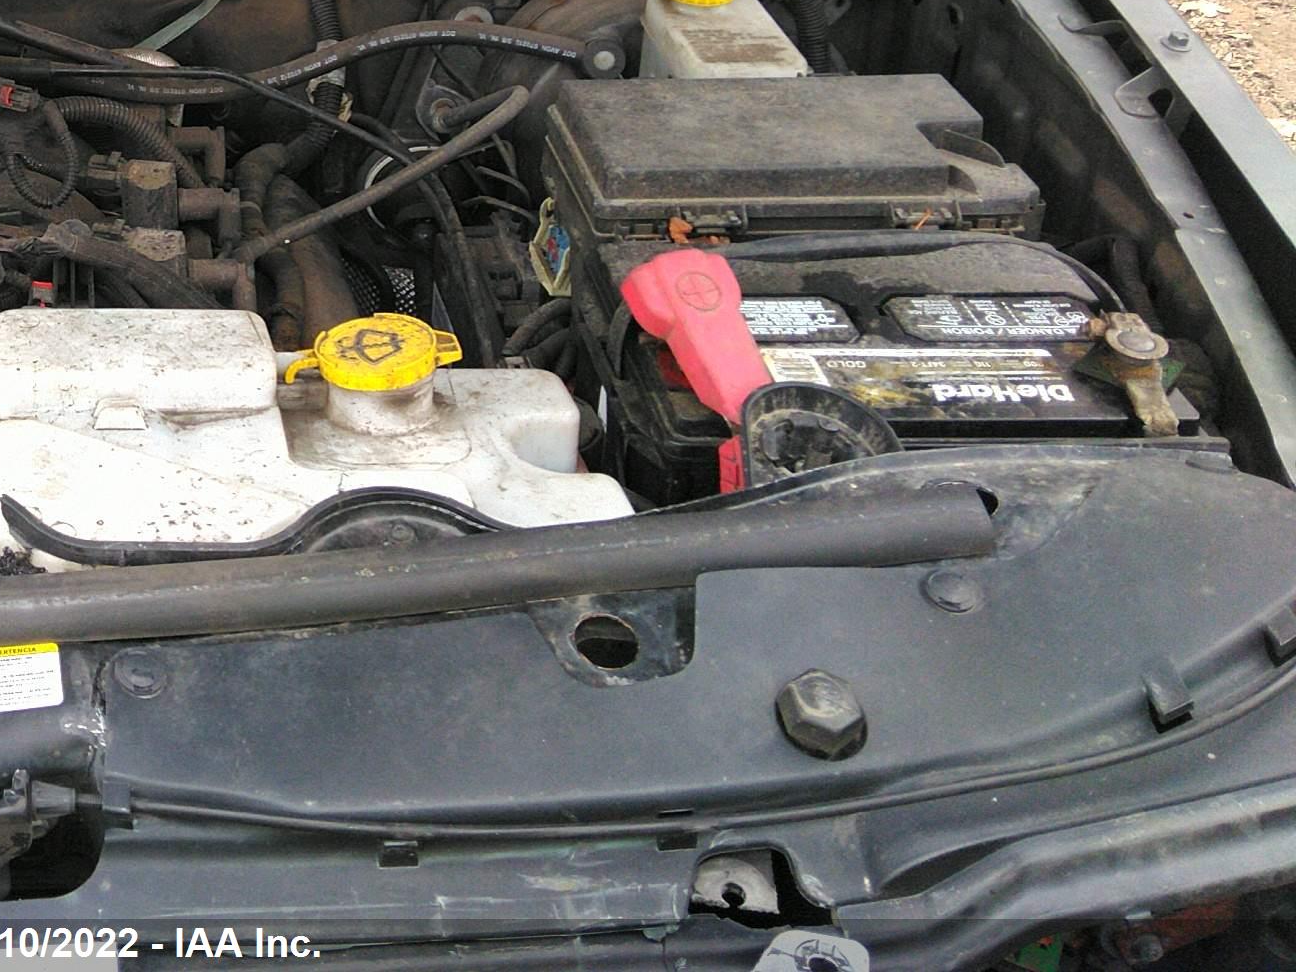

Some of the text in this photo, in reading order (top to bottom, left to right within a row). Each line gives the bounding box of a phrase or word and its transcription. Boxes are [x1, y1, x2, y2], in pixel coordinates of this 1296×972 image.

[941, 327, 995, 335] POISON
[1007, 327, 1064, 335] DANGER
[826, 360, 867, 369] GOLD
[931, 383, 1075, 403] DieHard
